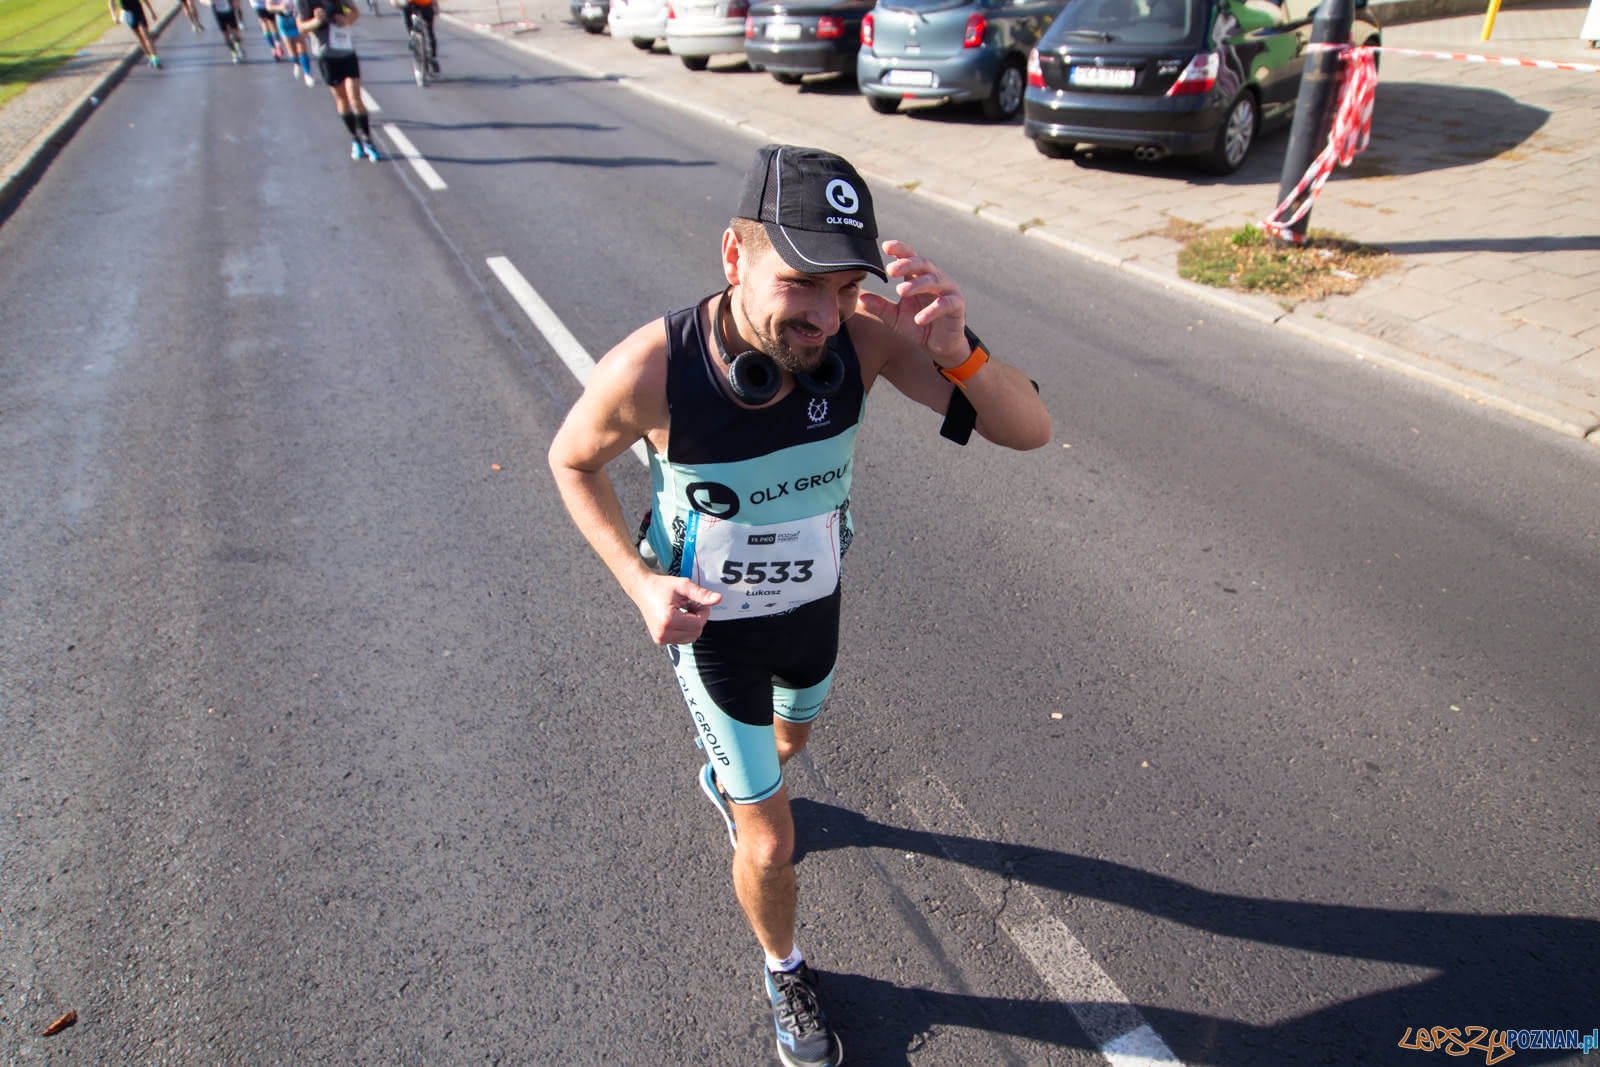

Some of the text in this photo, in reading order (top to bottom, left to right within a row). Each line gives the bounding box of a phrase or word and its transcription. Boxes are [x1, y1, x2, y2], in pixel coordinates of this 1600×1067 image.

[843, 218, 863, 229] GROUP
[750, 464, 847, 504] OLX GROU
[720, 559, 814, 584] 5533
[745, 589, 782, 597] Łukasz
[695, 711, 730, 767] GROUP
